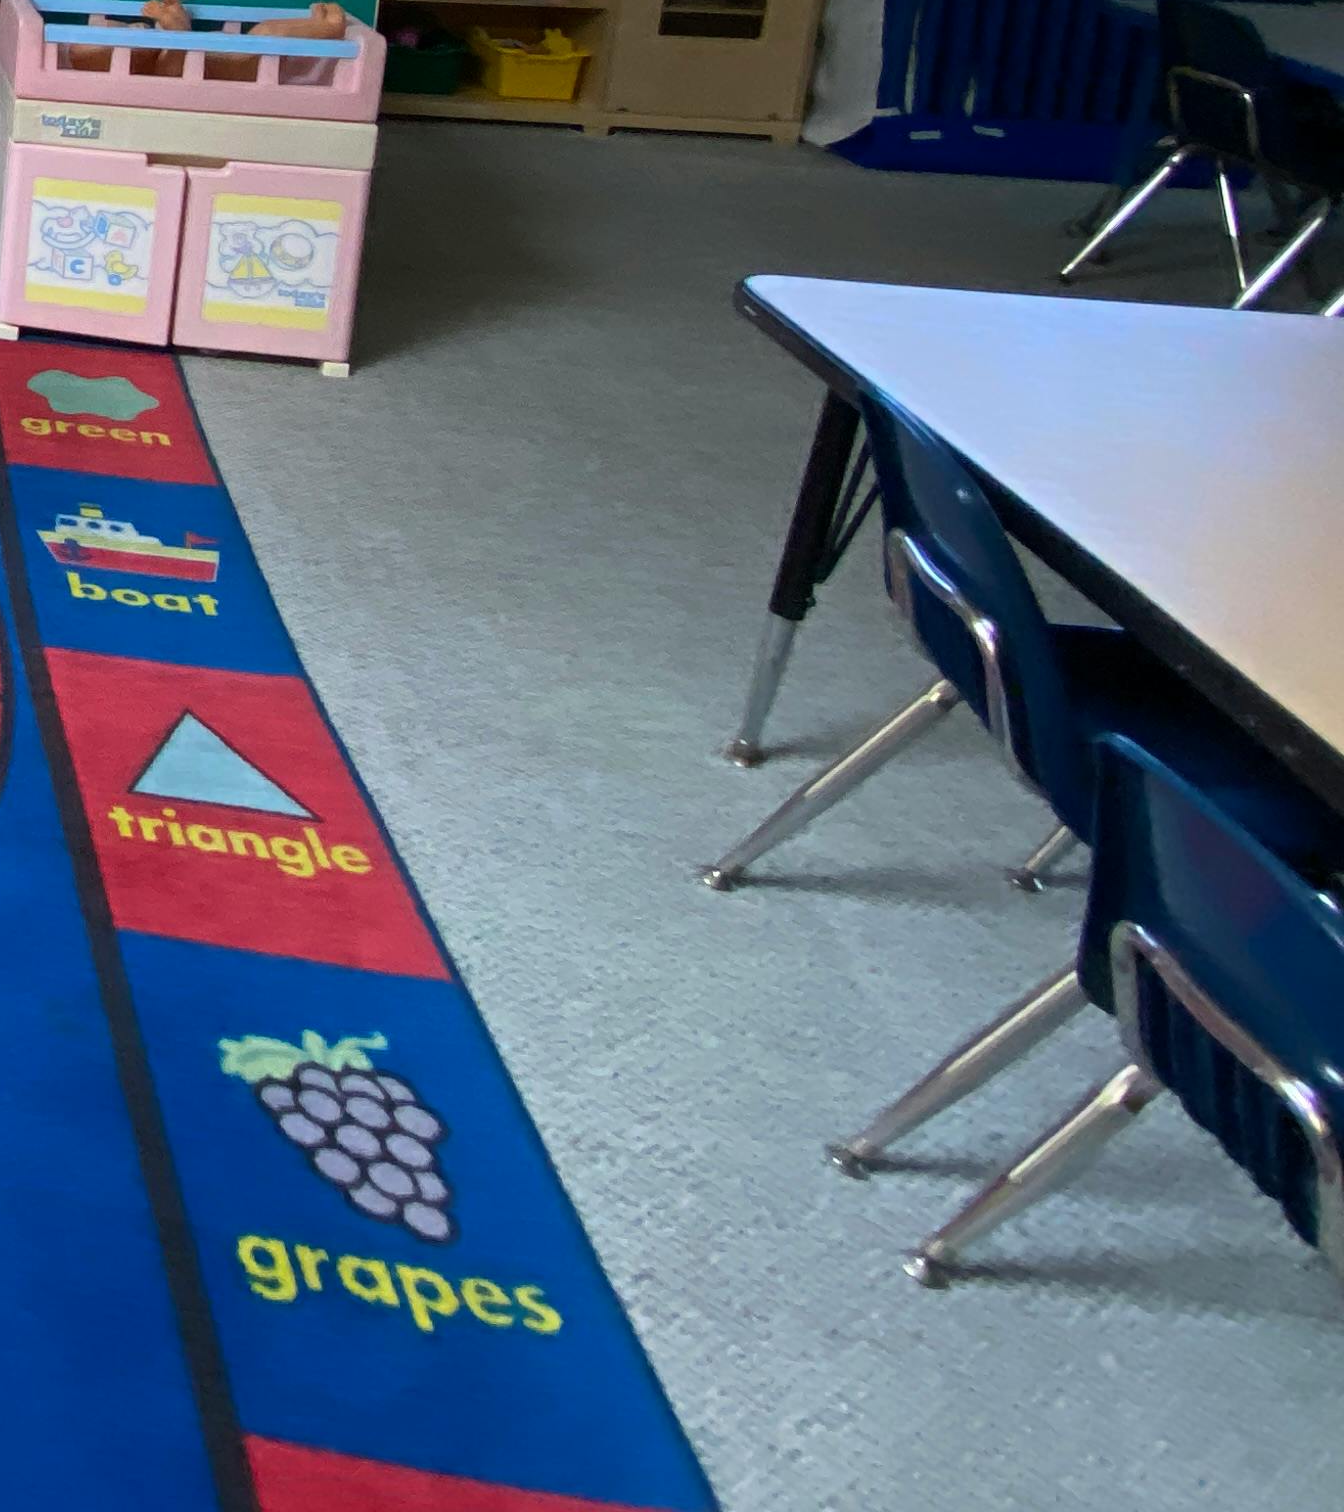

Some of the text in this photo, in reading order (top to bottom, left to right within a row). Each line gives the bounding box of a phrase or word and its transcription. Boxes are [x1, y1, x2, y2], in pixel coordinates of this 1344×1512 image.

[19, 417, 170, 446] green
[66, 571, 217, 616] boat
[108, 805, 369, 879] triangle
[237, 1234, 562, 1334] grapes
